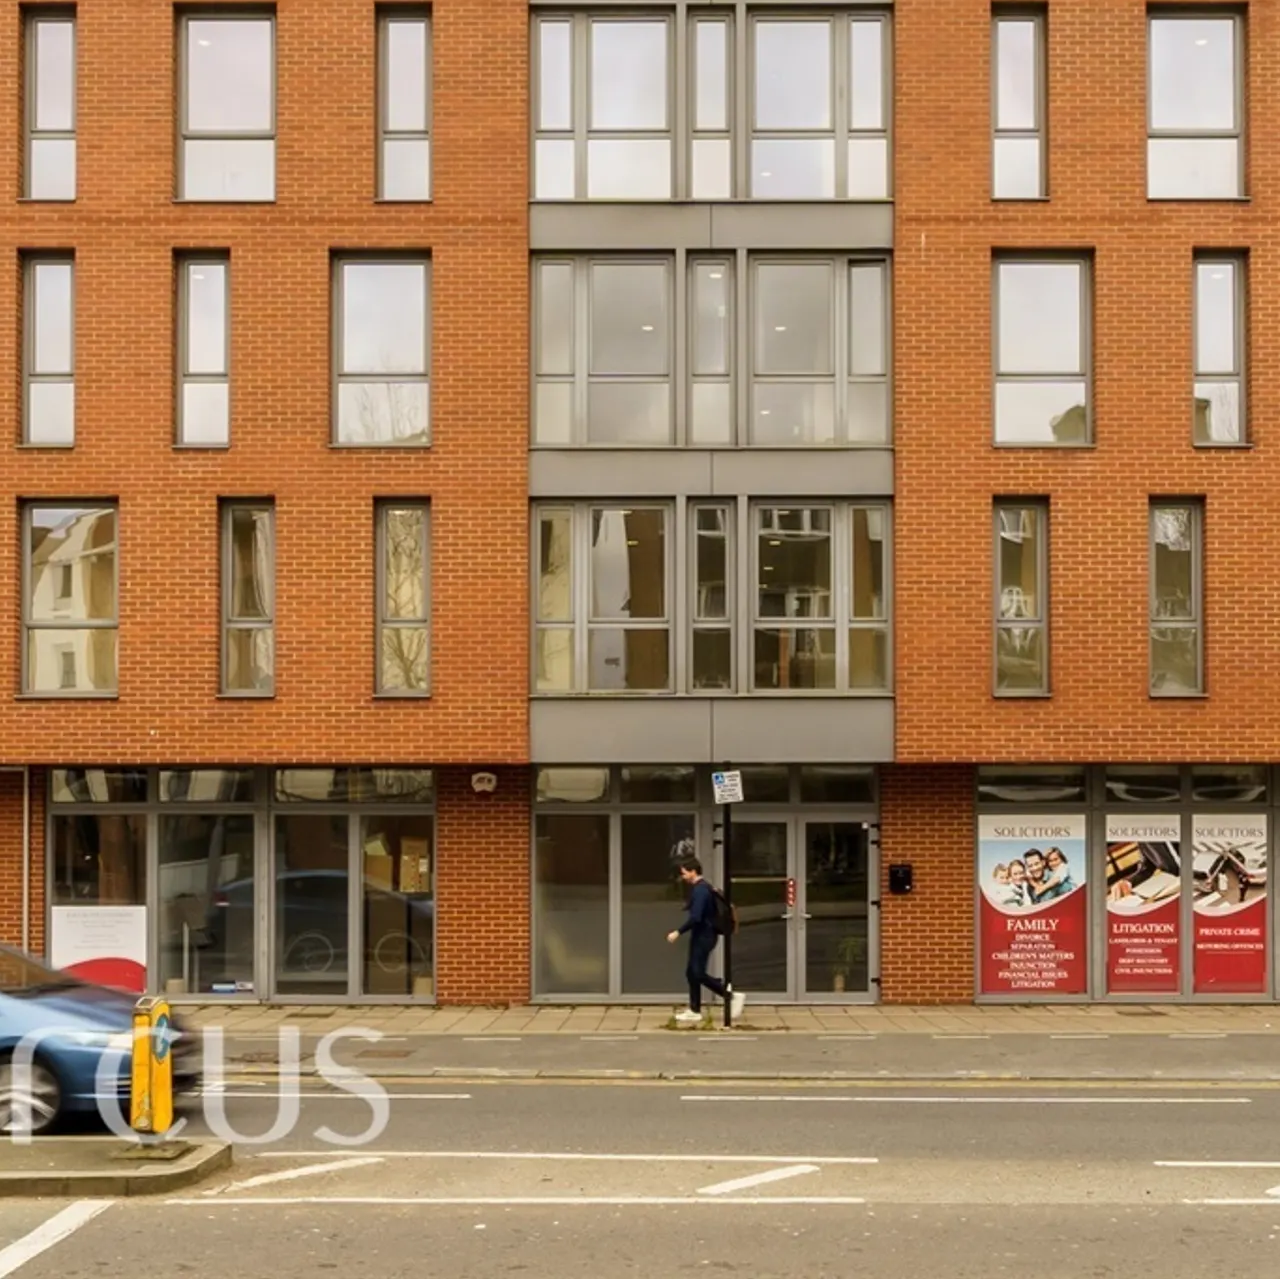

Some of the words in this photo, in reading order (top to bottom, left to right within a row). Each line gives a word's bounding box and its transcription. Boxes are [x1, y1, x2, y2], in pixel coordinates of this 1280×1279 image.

[993, 826, 1071, 838] SOLICITORS
[1108, 826, 1178, 837] SOLICITORS
[1195, 827, 1264, 838] SOLICITORS
[1006, 919, 1060, 931] FAMILY
[1112, 923, 1175, 933] LITIGATION
[1015, 933, 1050, 941] DIVORCE
[1199, 928, 1232, 936] PRIVATE
[1233, 928, 1260, 936] CRIME
[1039, 952, 1075, 960] MATTERS
[998, 971, 1040, 979] FINANCIAL
[1041, 971, 1069, 979] ISSUES
